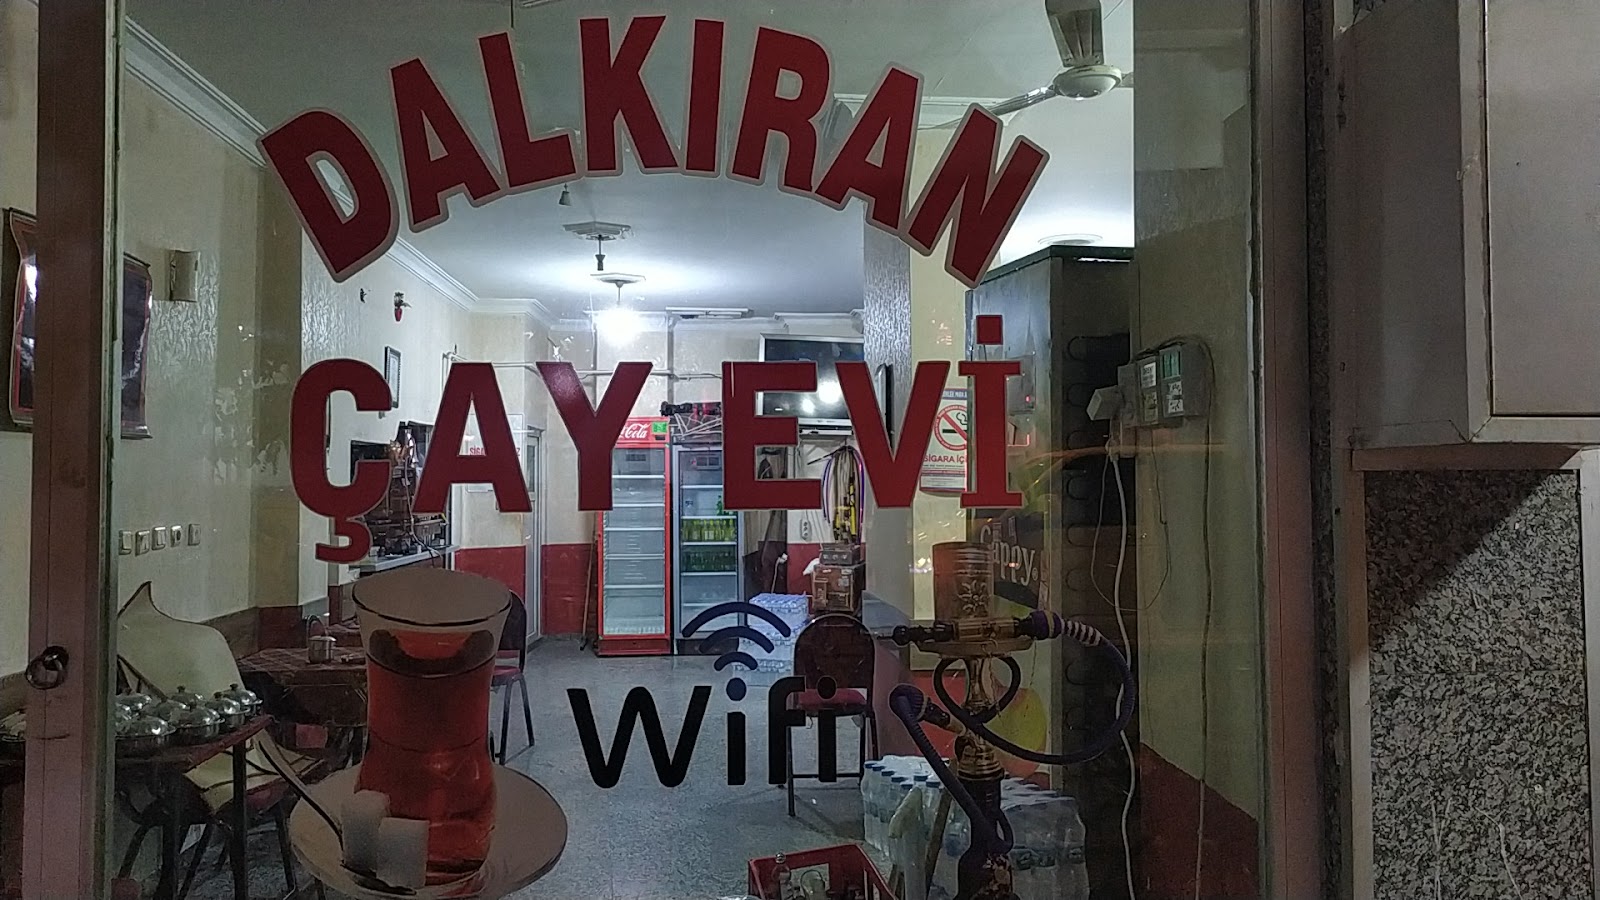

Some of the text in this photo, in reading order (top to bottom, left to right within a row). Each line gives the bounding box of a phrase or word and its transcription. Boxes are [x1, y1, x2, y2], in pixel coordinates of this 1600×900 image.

[257, 14, 1049, 285] DALKIRAN
[290, 314, 1023, 563] ÇAY EVİ
[924, 454, 955, 462] SİGARA
[566, 674, 838, 789] Wifi
